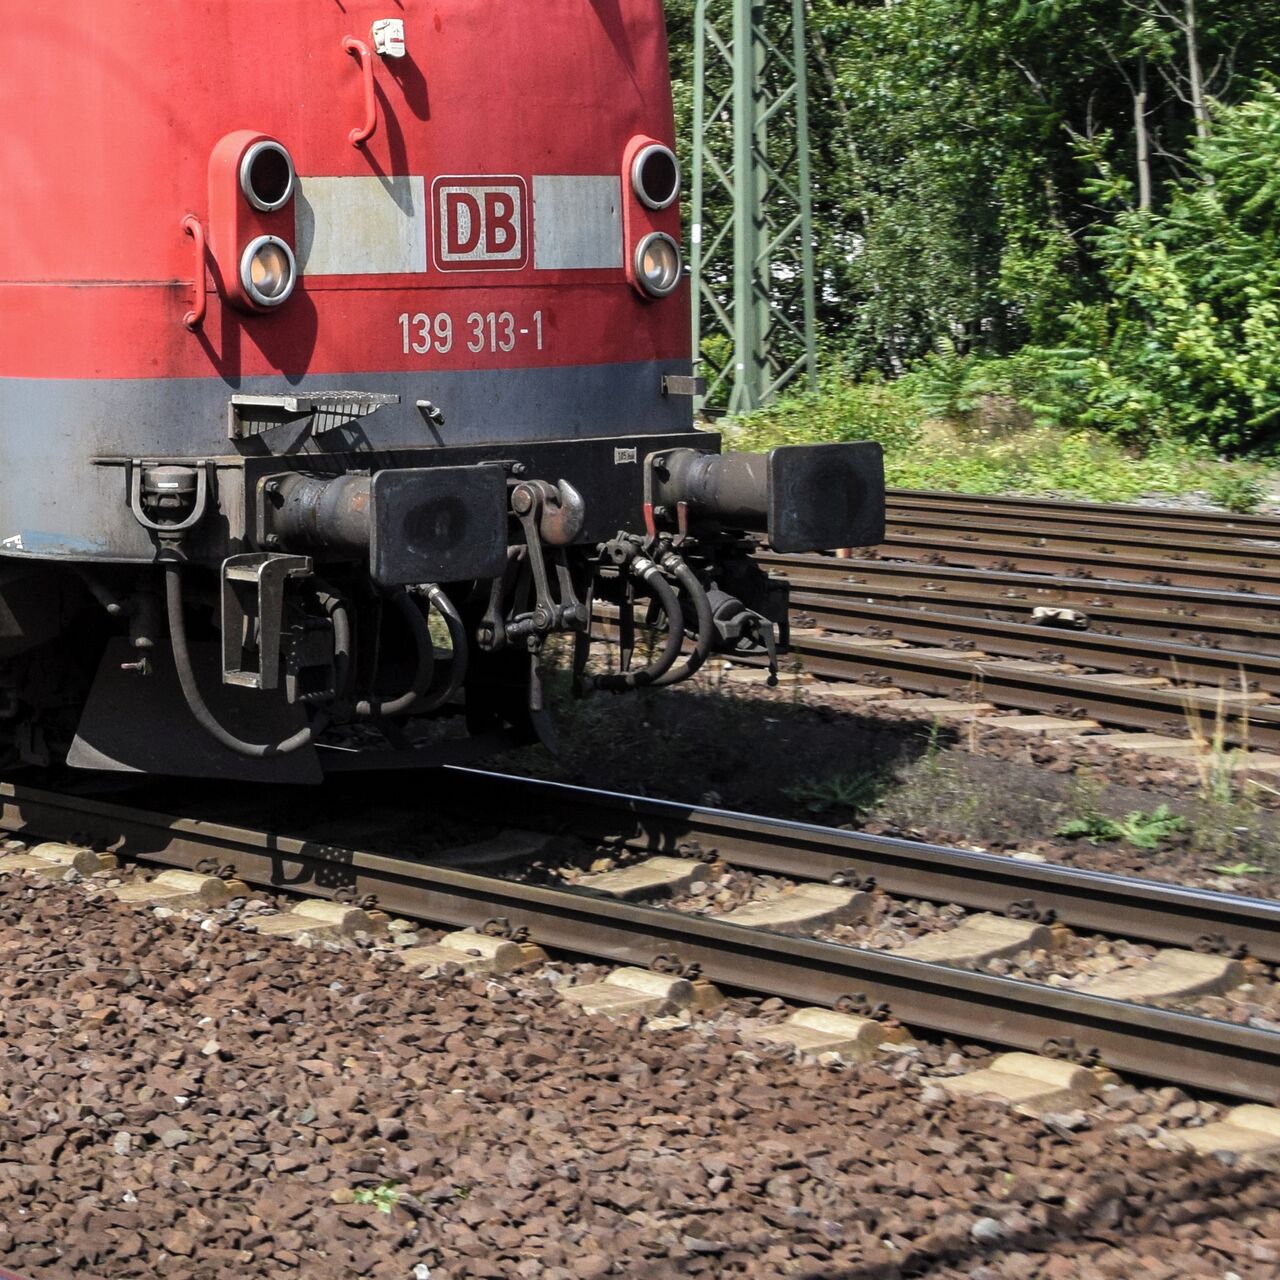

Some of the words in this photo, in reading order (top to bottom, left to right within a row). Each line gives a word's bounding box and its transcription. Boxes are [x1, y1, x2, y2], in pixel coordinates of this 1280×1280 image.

[446, 192, 517, 255] DB
[398, 312, 453, 354] 139
[466, 310, 543, 353] 313-1
